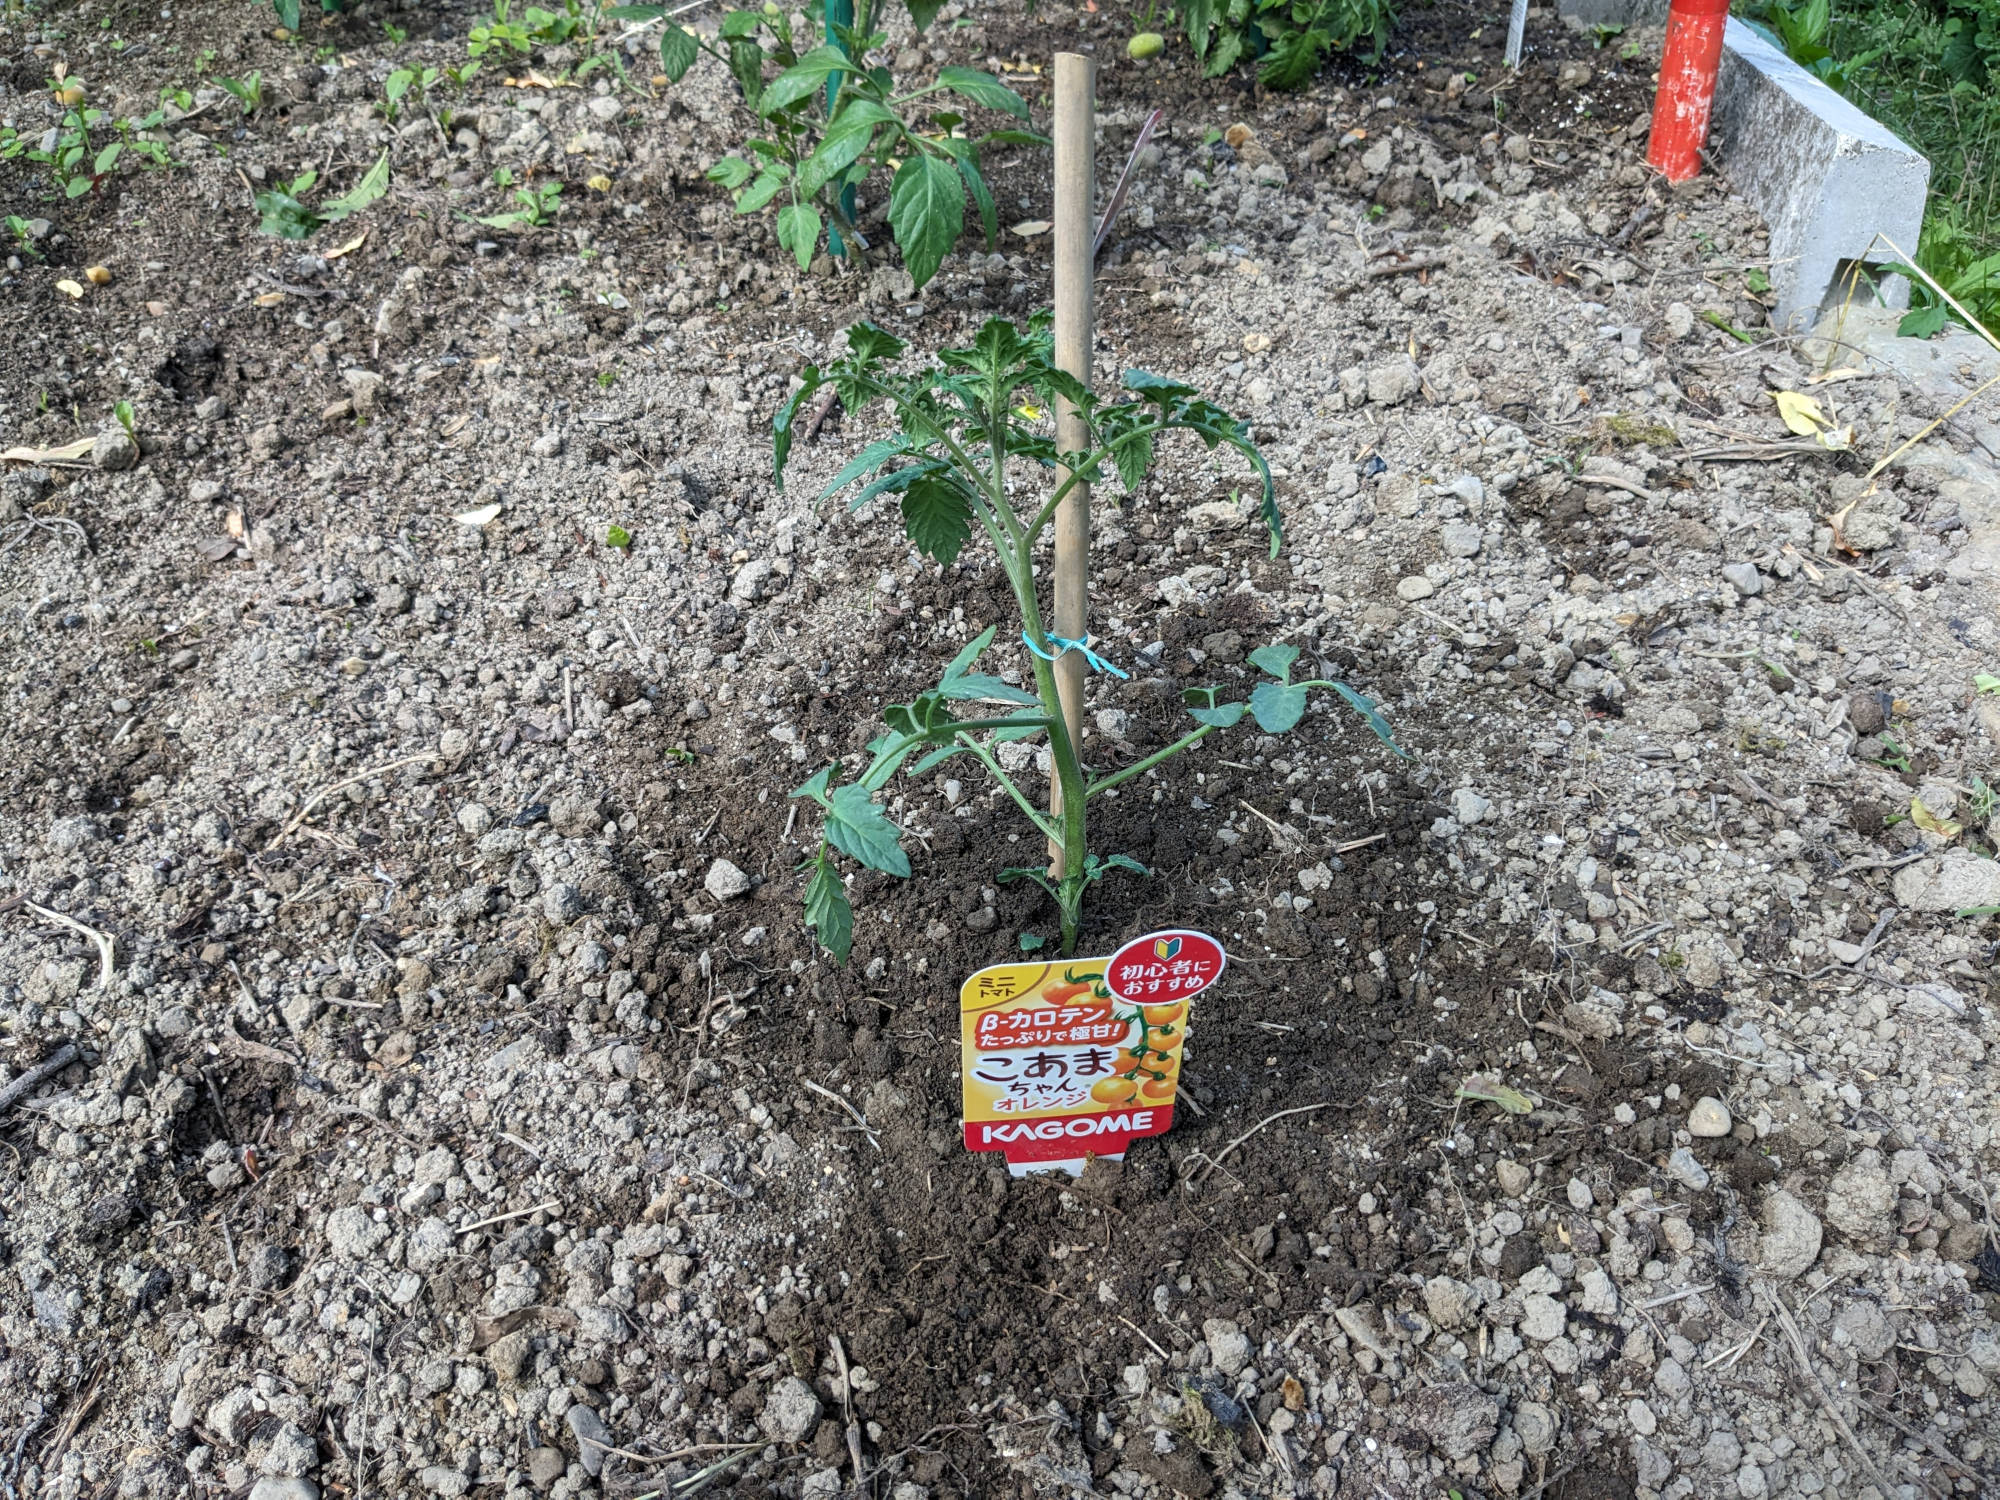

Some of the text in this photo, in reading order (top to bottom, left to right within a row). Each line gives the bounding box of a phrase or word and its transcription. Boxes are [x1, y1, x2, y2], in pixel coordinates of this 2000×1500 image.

[1120, 960, 1211, 980] 初心者に
[979, 976, 1016, 988] ミニ
[1123, 977, 1204, 996] おすすめ
[980, 988, 1015, 999] トマト
[976, 1048, 1113, 1082] こあま
[1008, 1078, 1077, 1096] ちゃん
[995, 1091, 1086, 1111] オレンジ
[982, 1111, 1154, 1144] KAGOME
